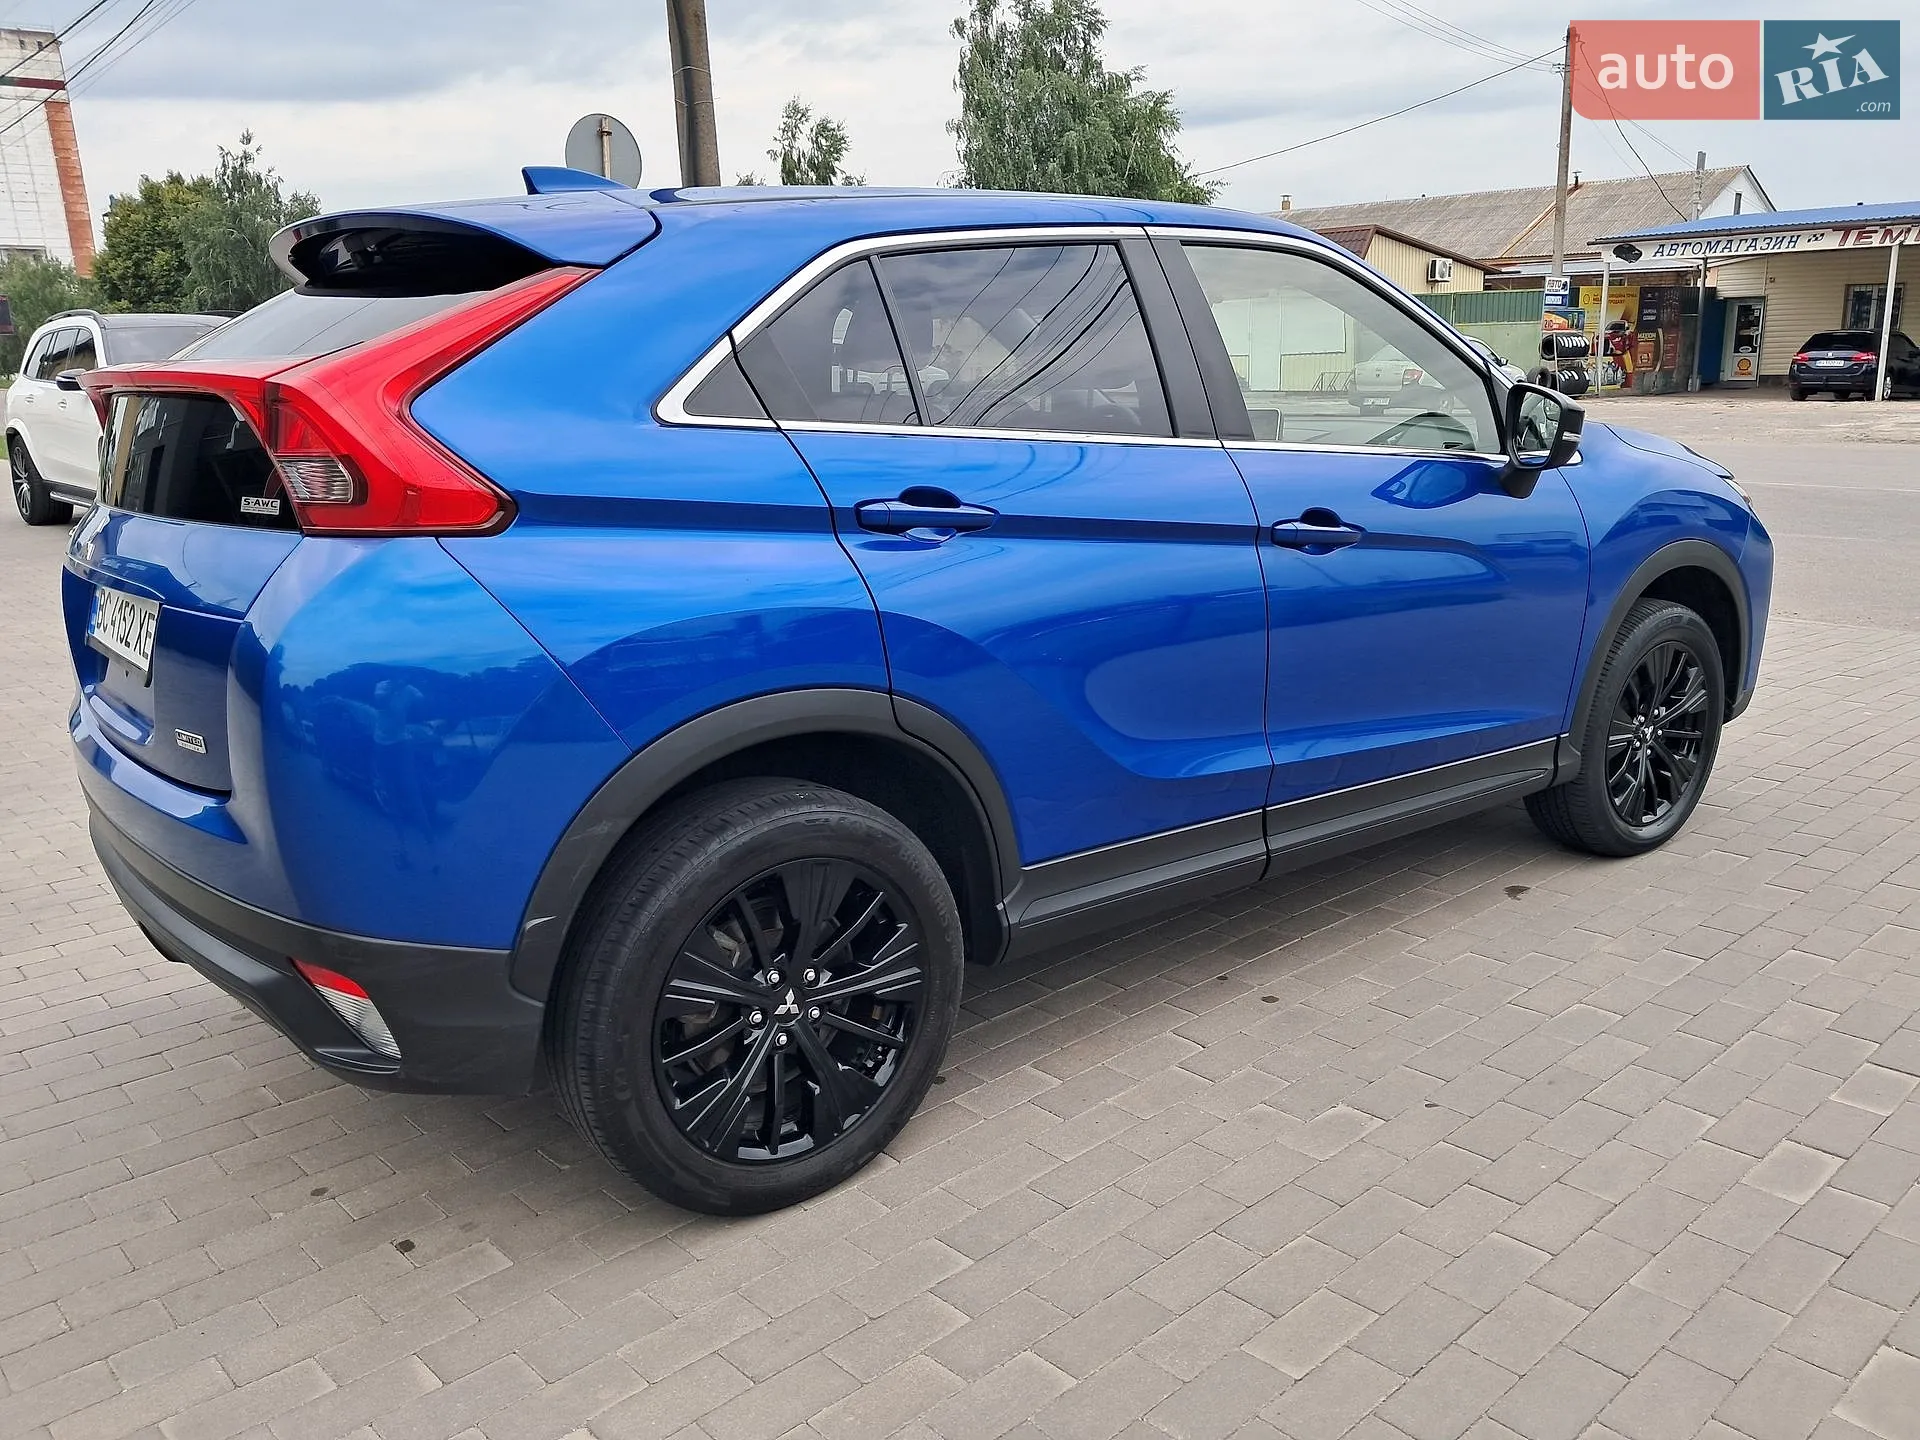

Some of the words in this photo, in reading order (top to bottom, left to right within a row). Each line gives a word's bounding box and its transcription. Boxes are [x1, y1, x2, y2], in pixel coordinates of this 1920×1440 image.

[1652, 234, 1801, 258] АВТОМАГАЗИН
[243, 498, 279, 508] S-AWC
[97, 588, 112, 633] BC
[111, 596, 136, 648] 4152
[133, 607, 156, 660] XE
